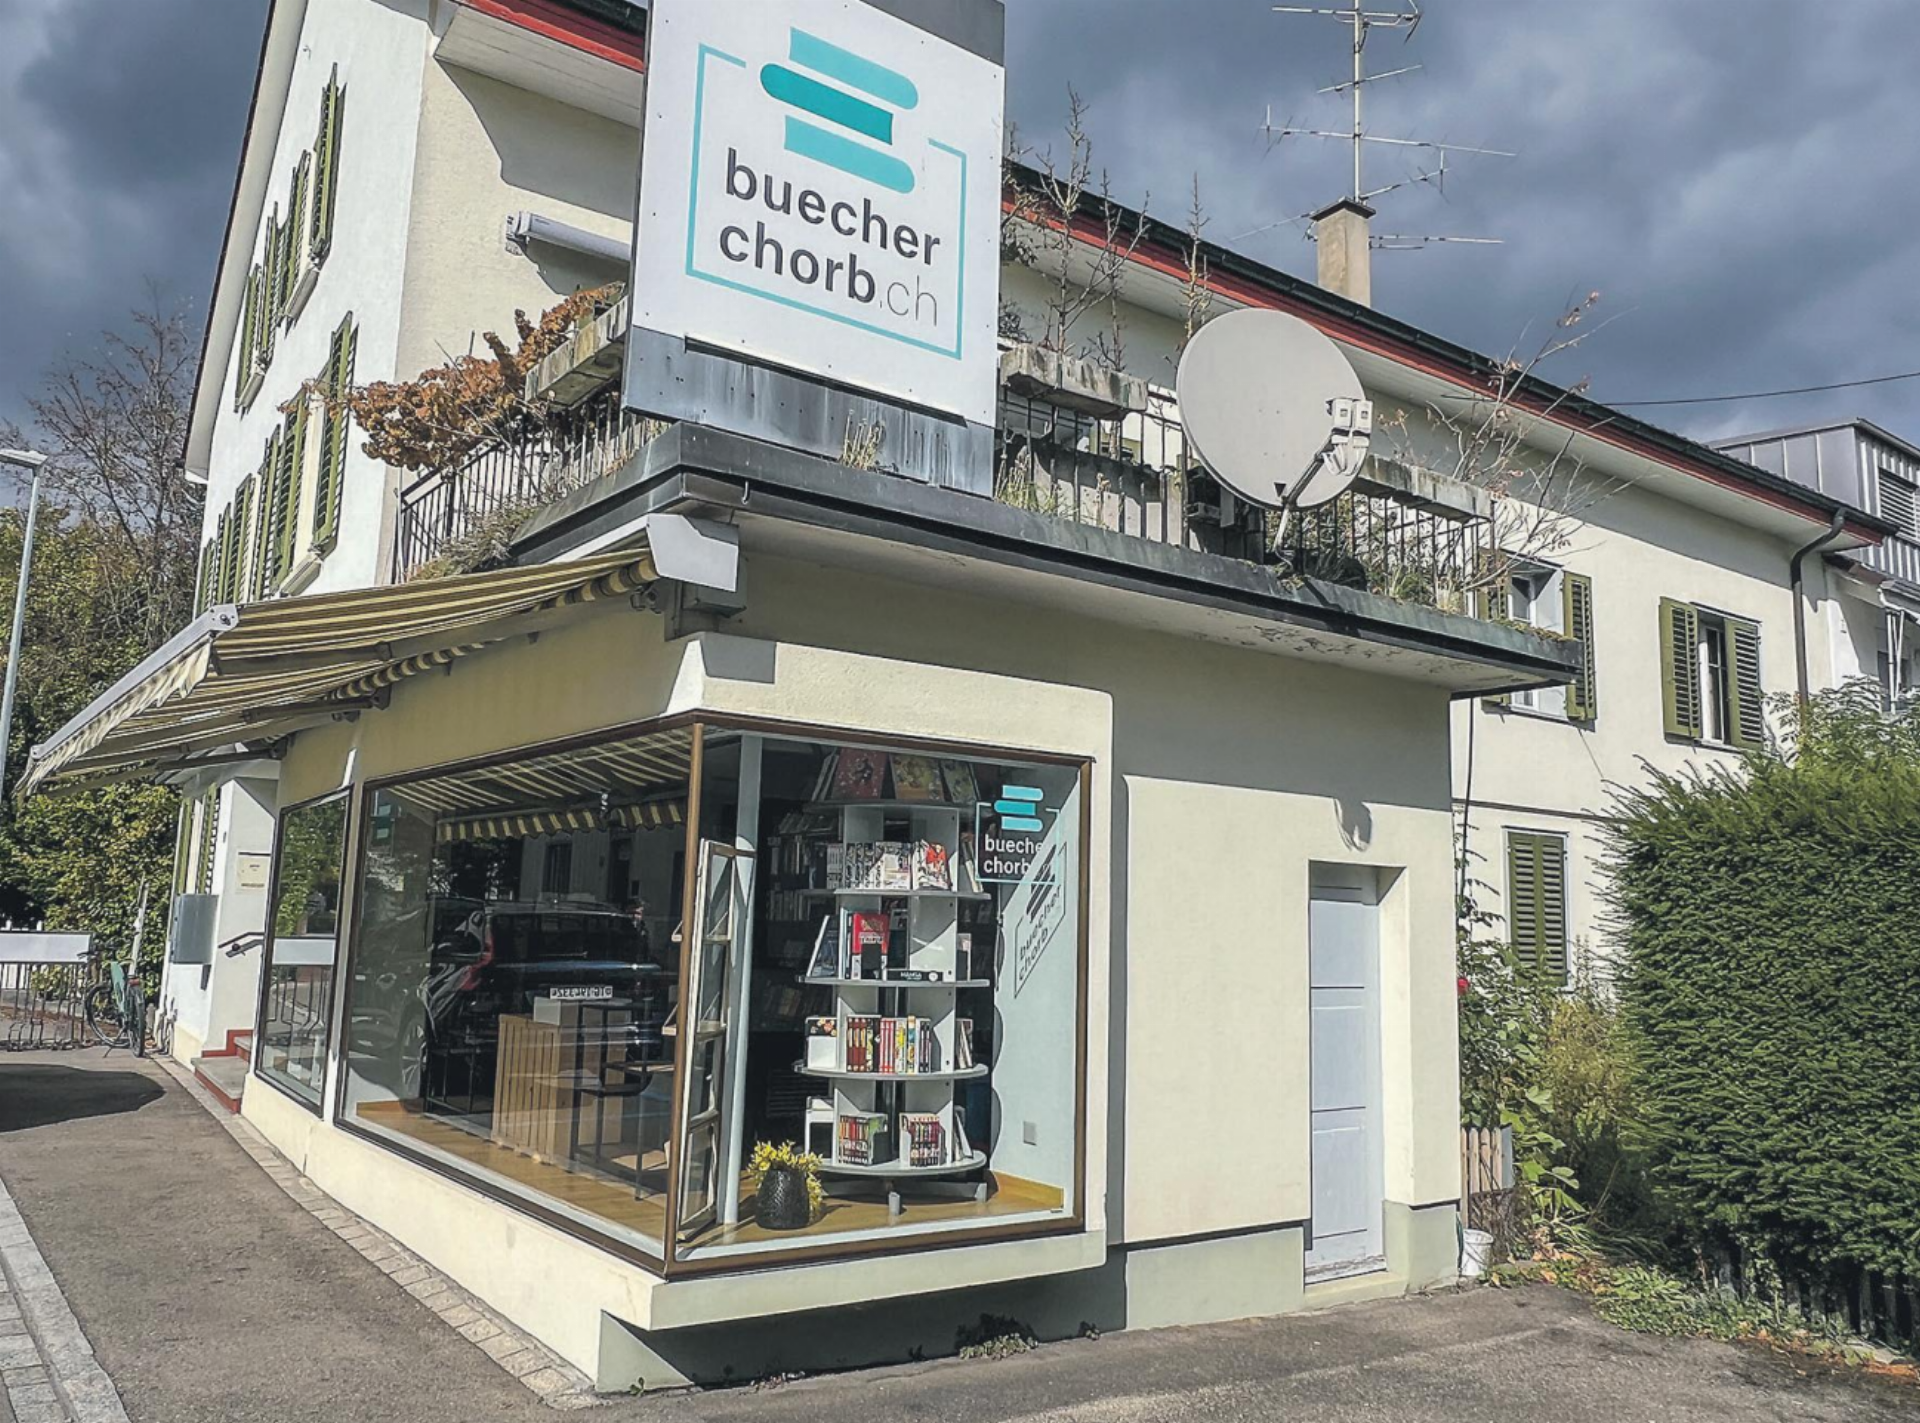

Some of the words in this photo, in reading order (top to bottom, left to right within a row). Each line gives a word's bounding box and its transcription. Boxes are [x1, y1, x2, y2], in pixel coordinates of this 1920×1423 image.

[726, 147, 941, 266] buecher
[719, 220, 937, 326] chorb.ch
[985, 833, 1044, 854] bueche
